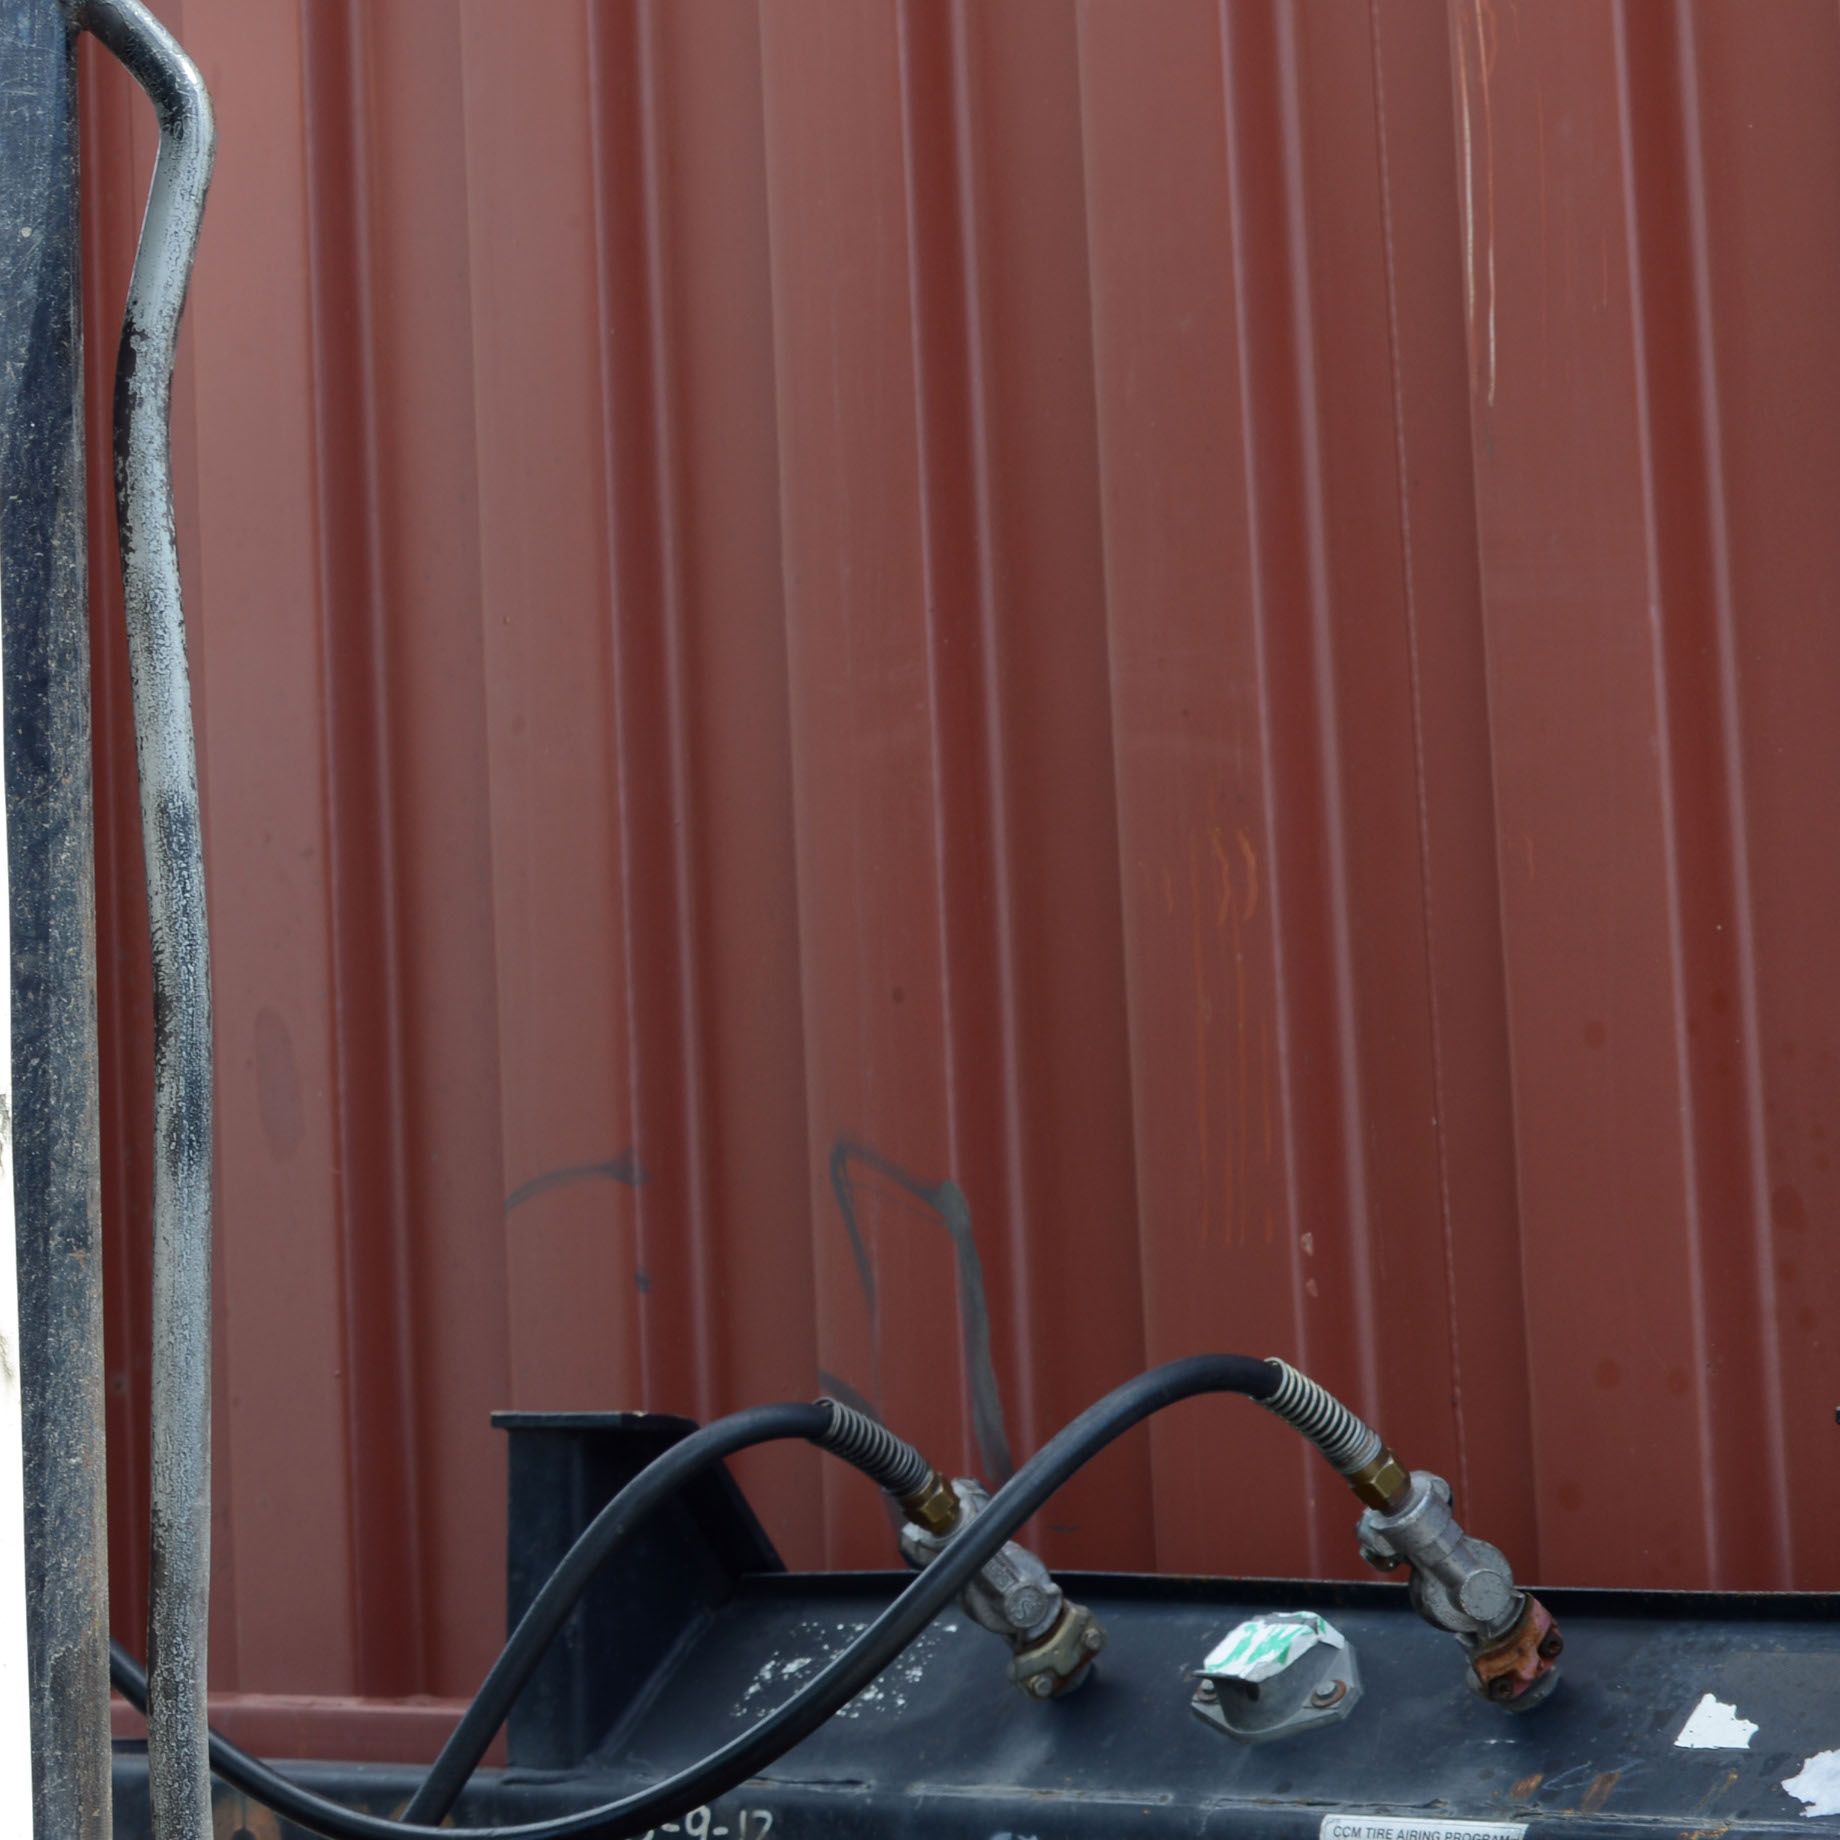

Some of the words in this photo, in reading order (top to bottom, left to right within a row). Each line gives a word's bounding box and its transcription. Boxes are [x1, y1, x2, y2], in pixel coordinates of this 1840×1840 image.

[1332, 1825, 1362, 1838] CCM
[1365, 1827, 1394, 1840] TIRE
[1396, 1828, 1441, 1840] AIRING
